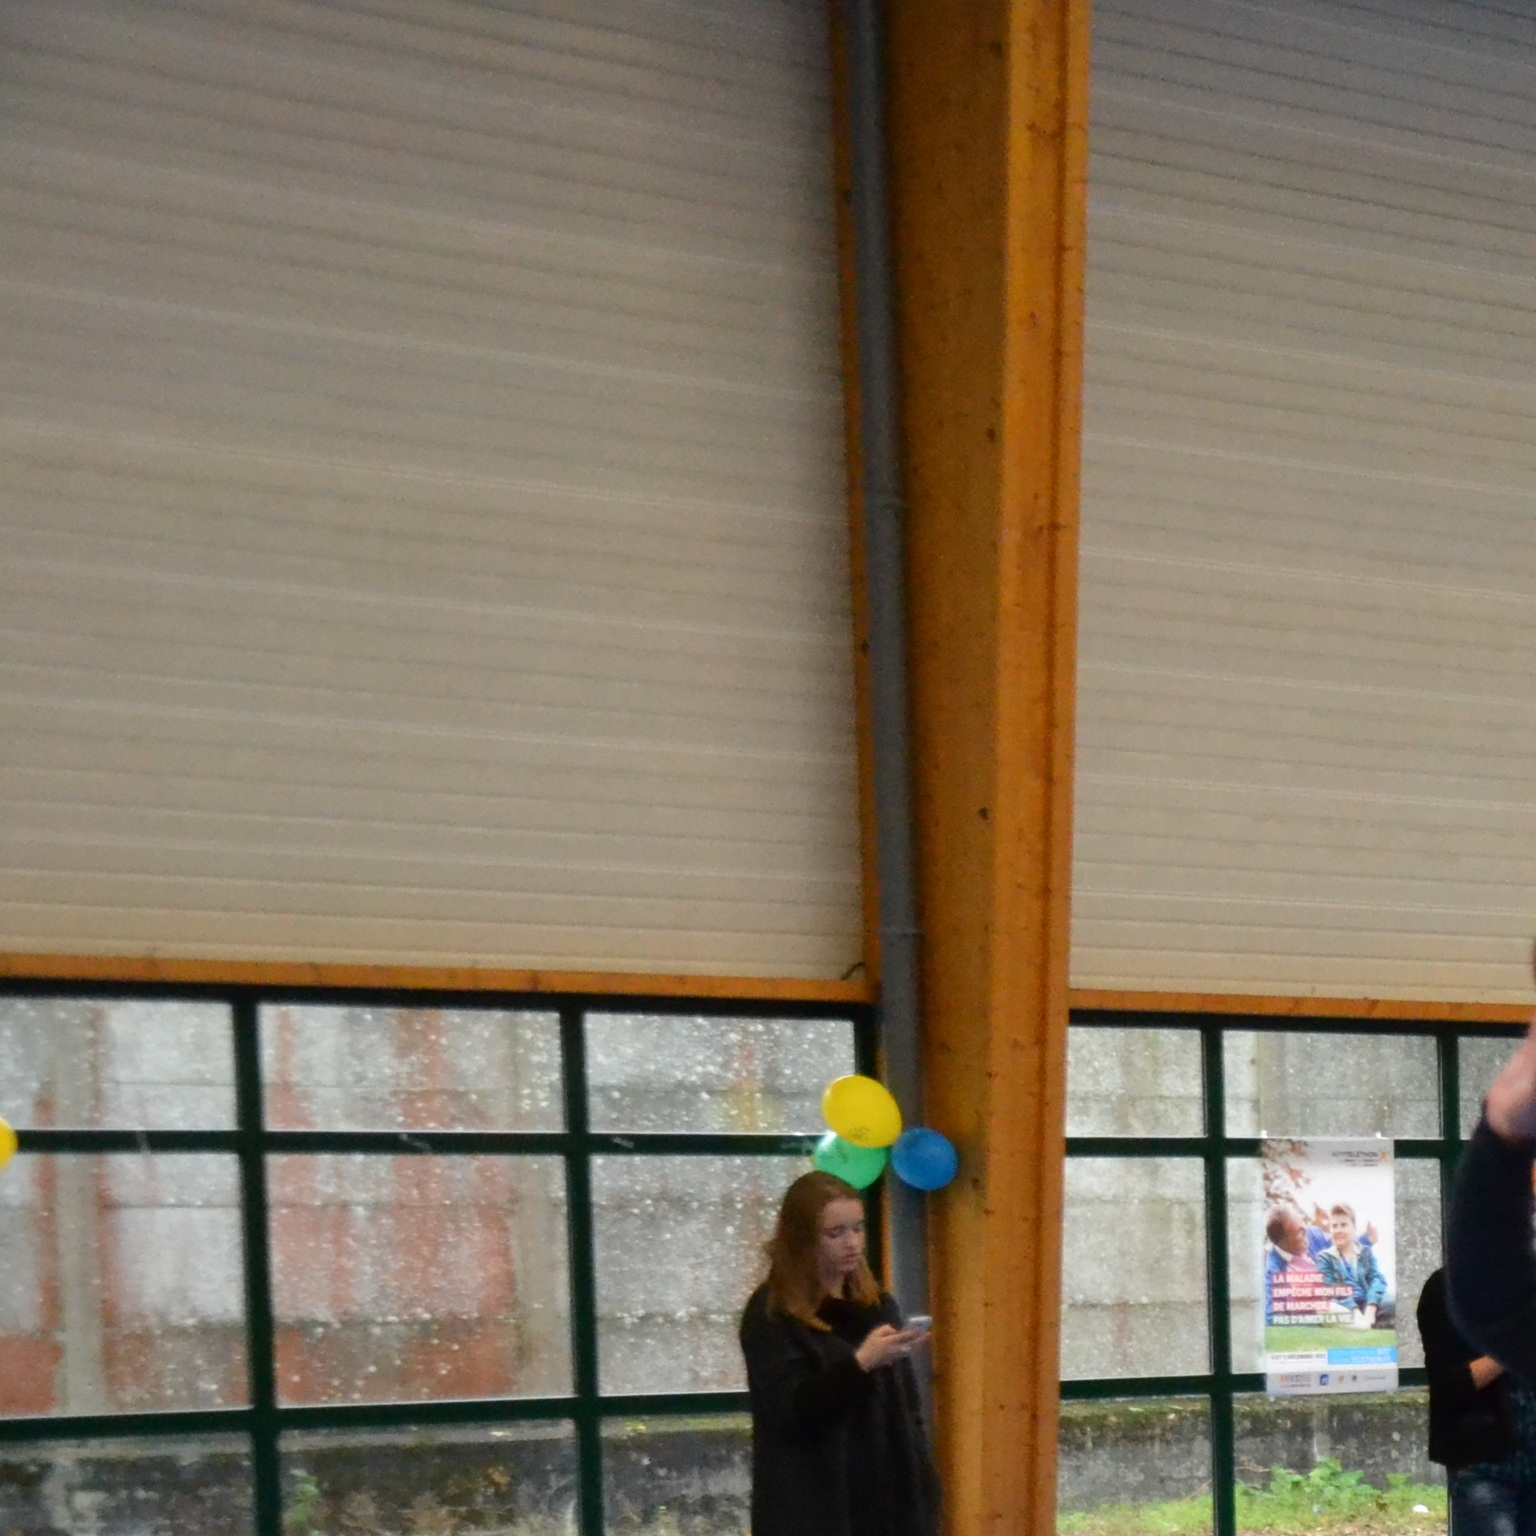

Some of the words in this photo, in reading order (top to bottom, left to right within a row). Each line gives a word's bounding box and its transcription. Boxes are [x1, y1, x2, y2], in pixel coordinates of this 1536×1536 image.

[1273, 1274, 1285, 1283] LA
[1286, 1273, 1324, 1283] MALADIE
[1335, 1286, 1354, 1296] FILS
[1273, 1302, 1285, 1311] DE
[1273, 1315, 1290, 1325] PAS
[1325, 1314, 1337, 1323] LA
